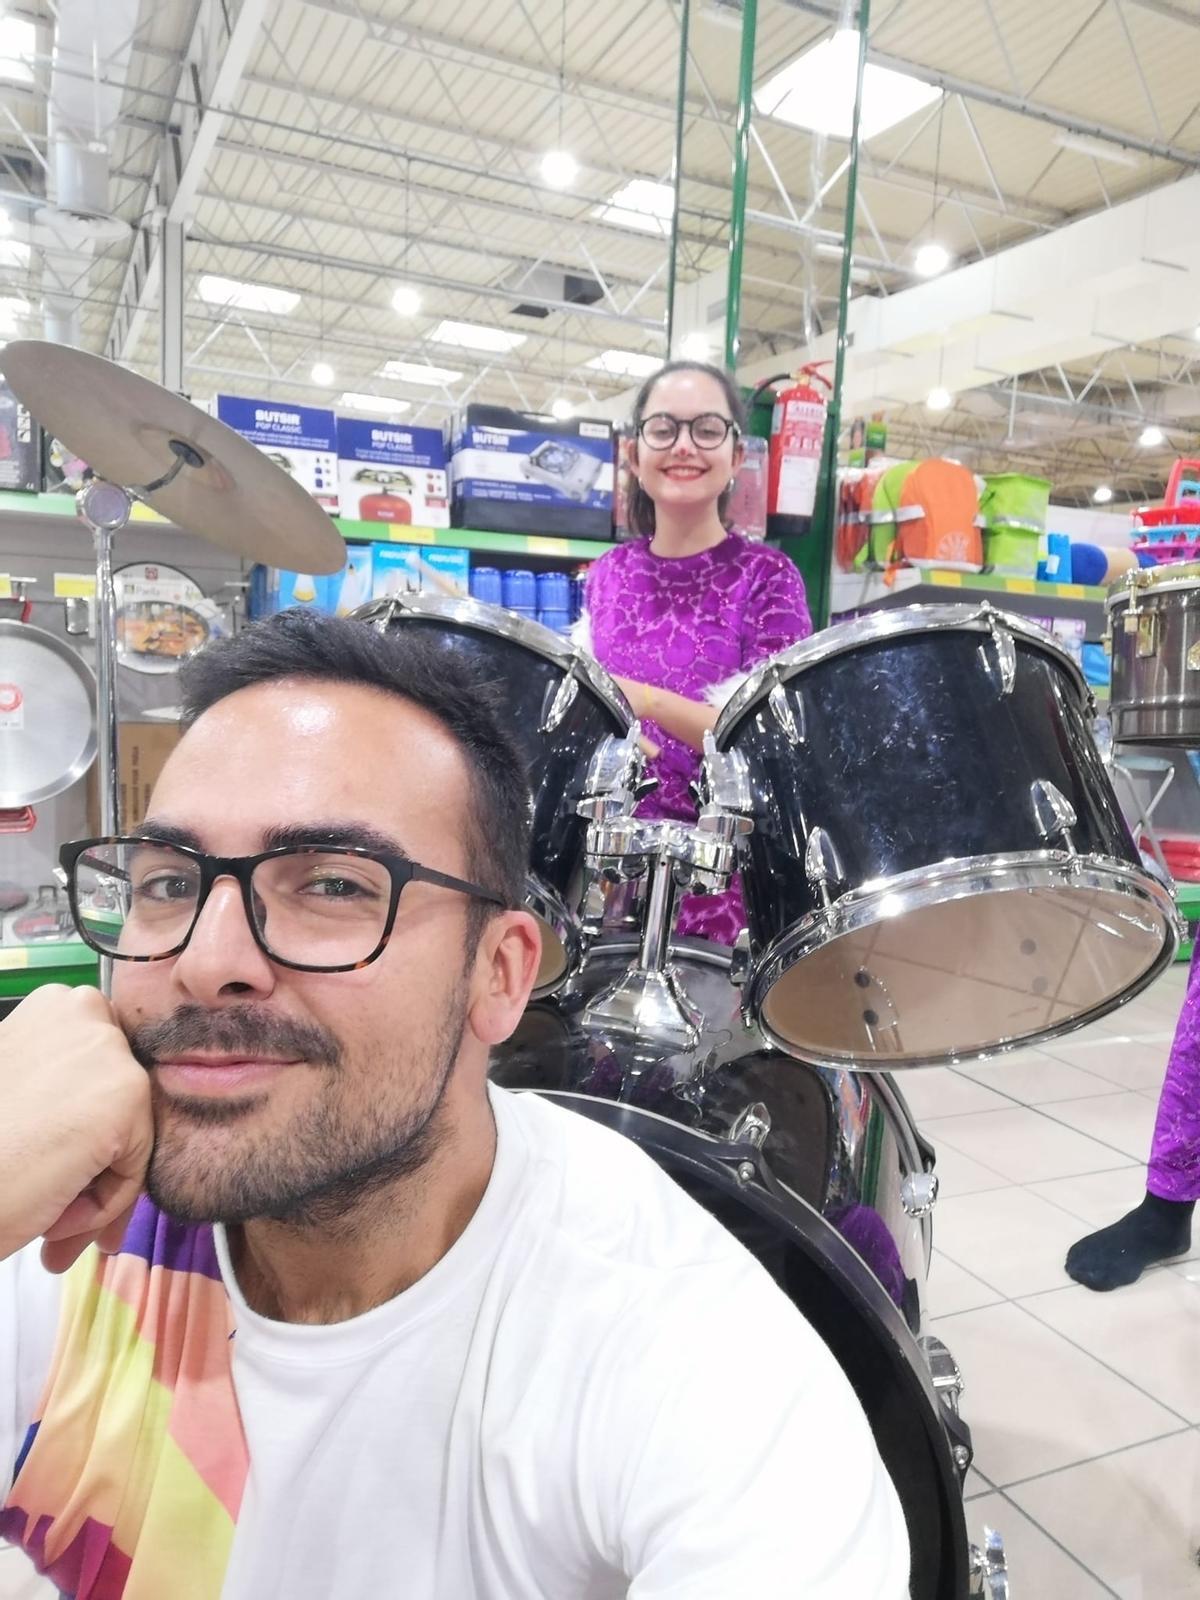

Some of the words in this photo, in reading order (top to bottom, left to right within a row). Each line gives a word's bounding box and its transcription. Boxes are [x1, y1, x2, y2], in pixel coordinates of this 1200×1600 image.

[255, 409, 301, 426] BUTSIR
[371, 429, 413, 444] BUTSIR
[472, 431, 509, 446] BUTSIR
